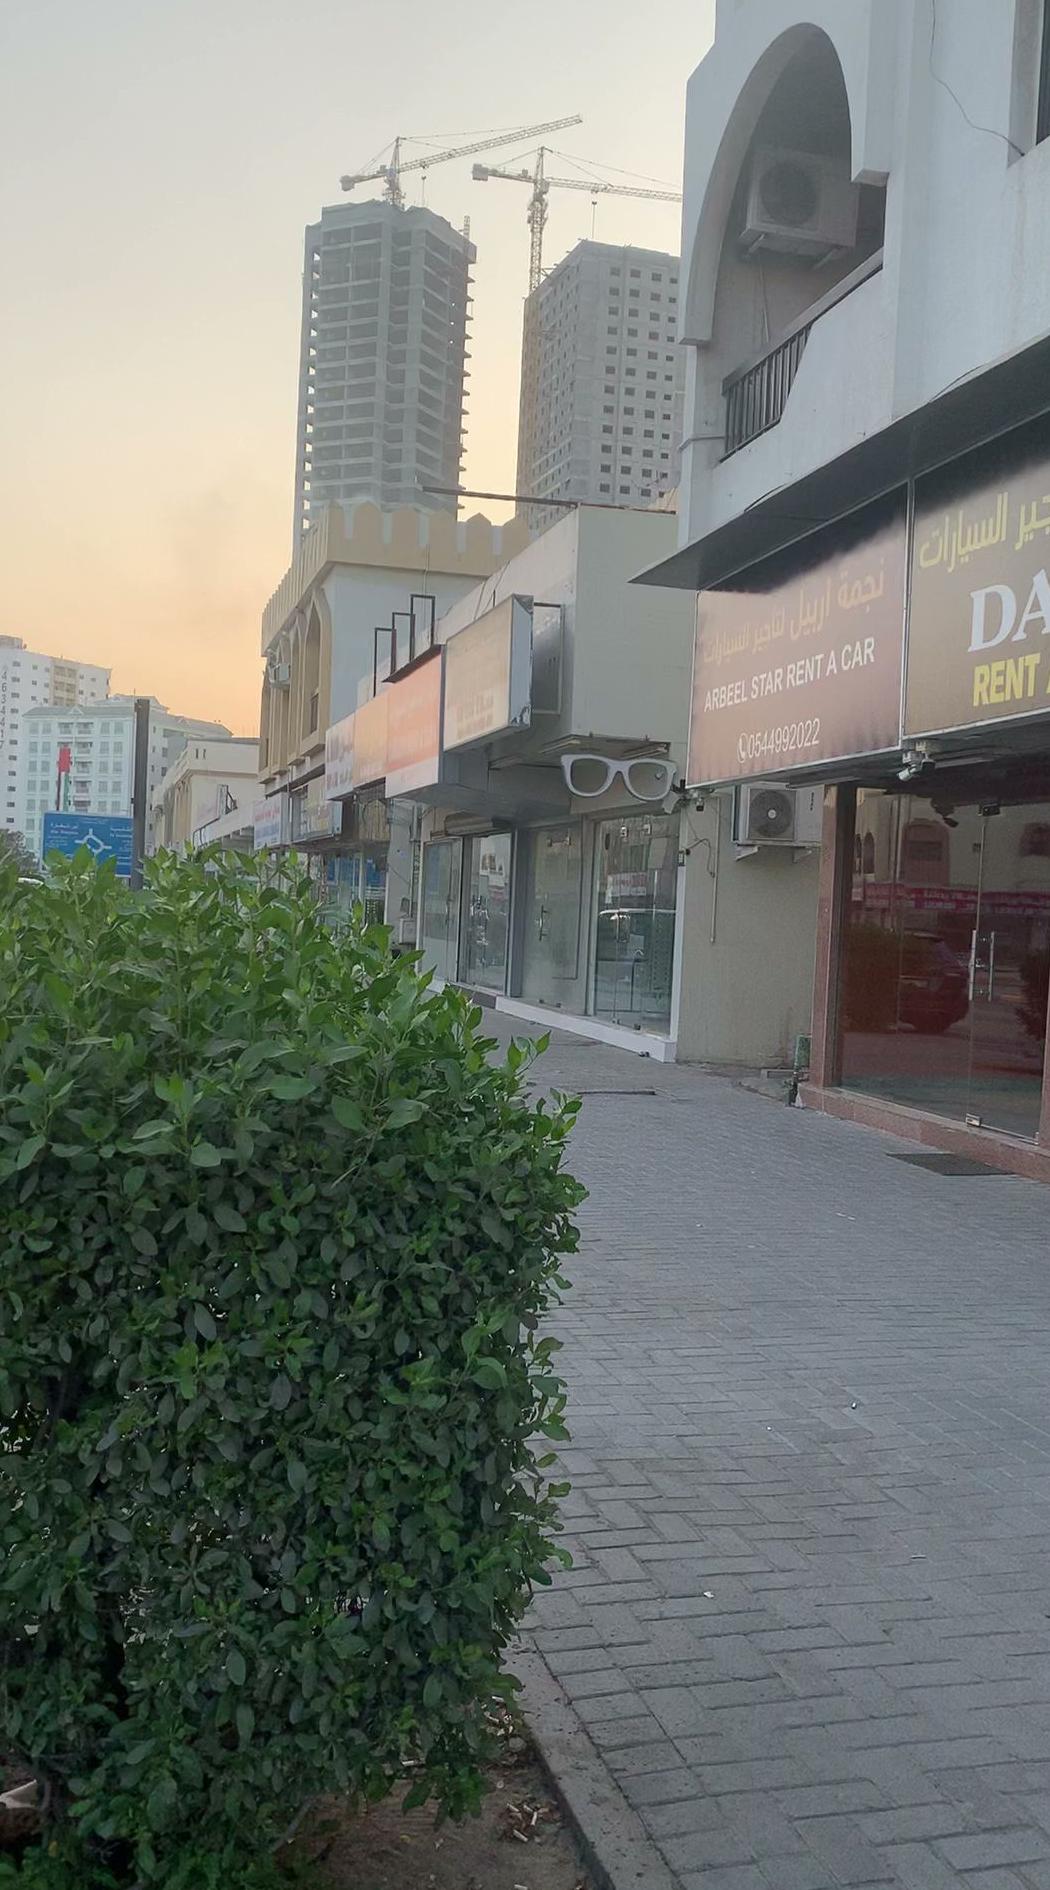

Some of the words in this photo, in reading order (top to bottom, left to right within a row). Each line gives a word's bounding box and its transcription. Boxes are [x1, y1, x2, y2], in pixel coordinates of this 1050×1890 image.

[919, 492, 1008, 573] السيارات
[837, 557, 886, 614] نجمة
[704, 679, 748, 712] ARBEEL
[751, 668, 783, 699] STAR
[786, 653, 824, 689] RENT
[826, 650, 837, 677] A
[841, 637, 875, 671] CAR
[973, 652, 1040, 706] RENT
[748, 717, 820, 759] 0544992022
